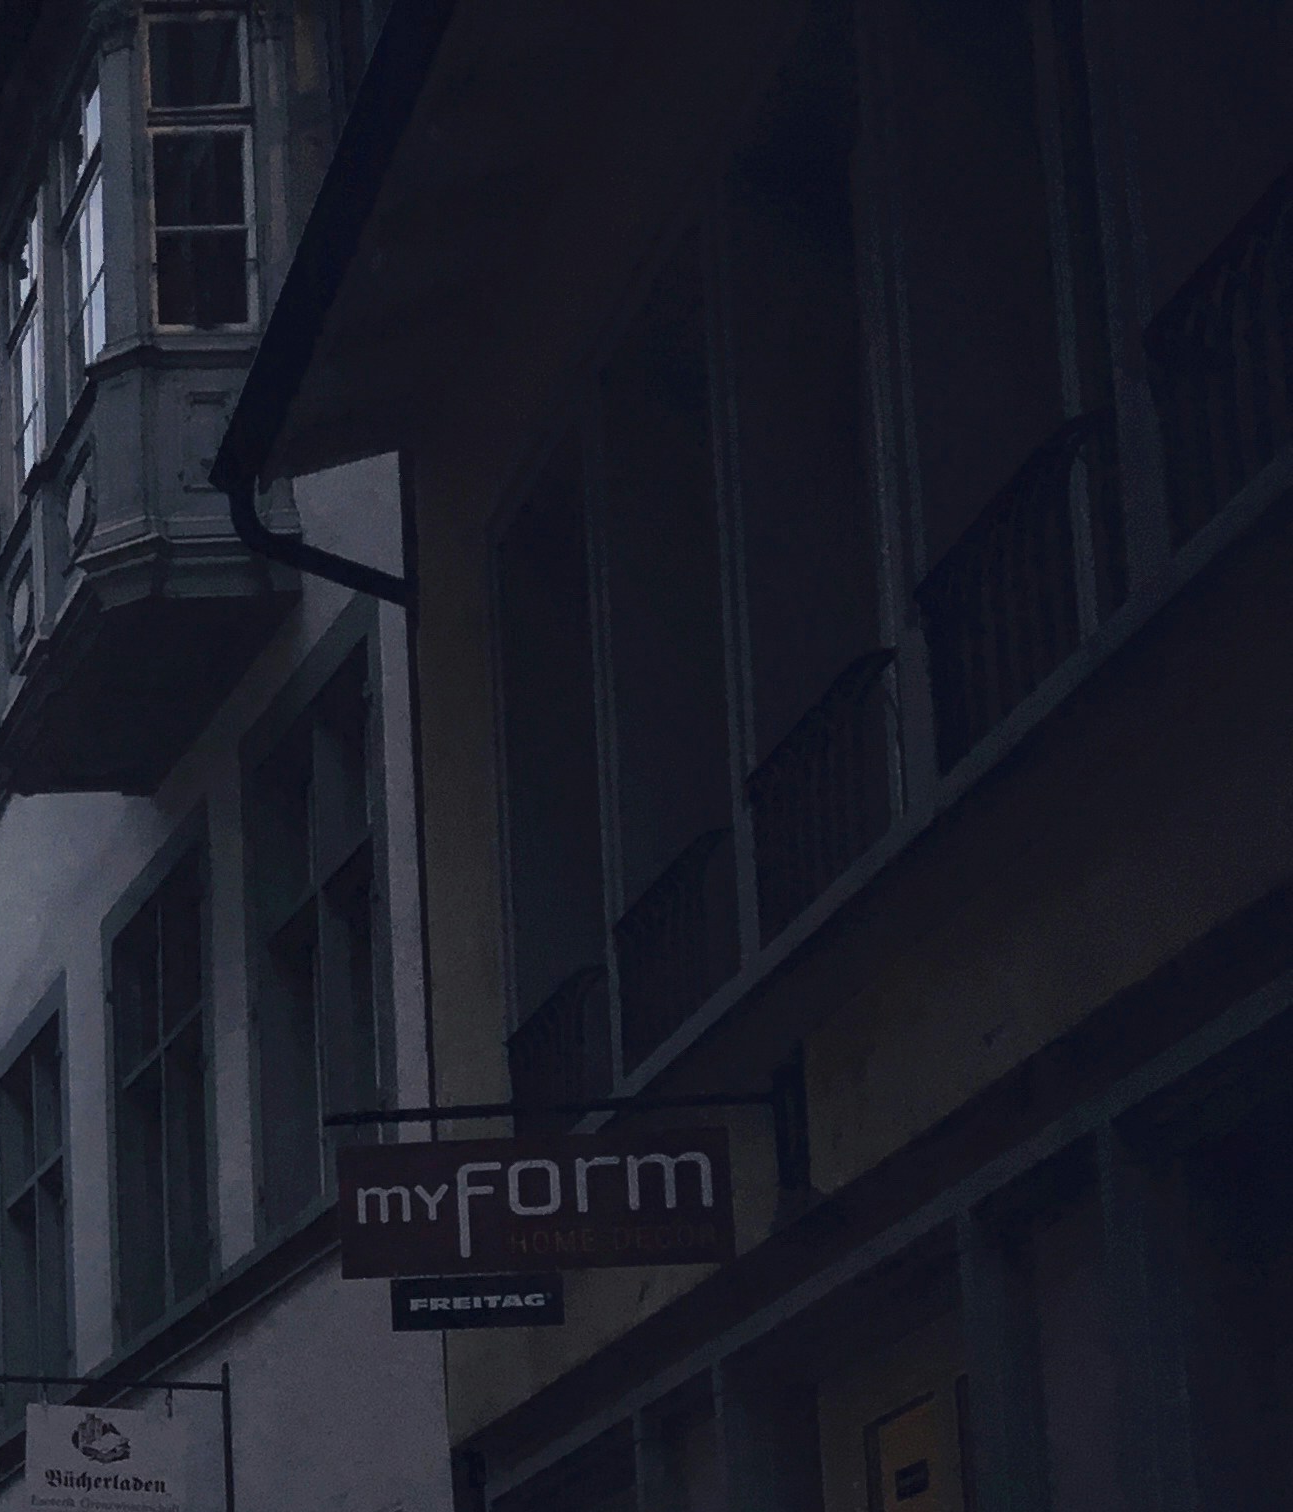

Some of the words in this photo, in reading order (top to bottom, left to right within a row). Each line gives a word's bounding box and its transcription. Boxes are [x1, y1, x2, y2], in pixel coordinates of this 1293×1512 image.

[509, 1227, 598, 1255] HOME
[409, 1292, 546, 1312] FREITAG
[44, 1469, 167, 1494] Bücherladen
